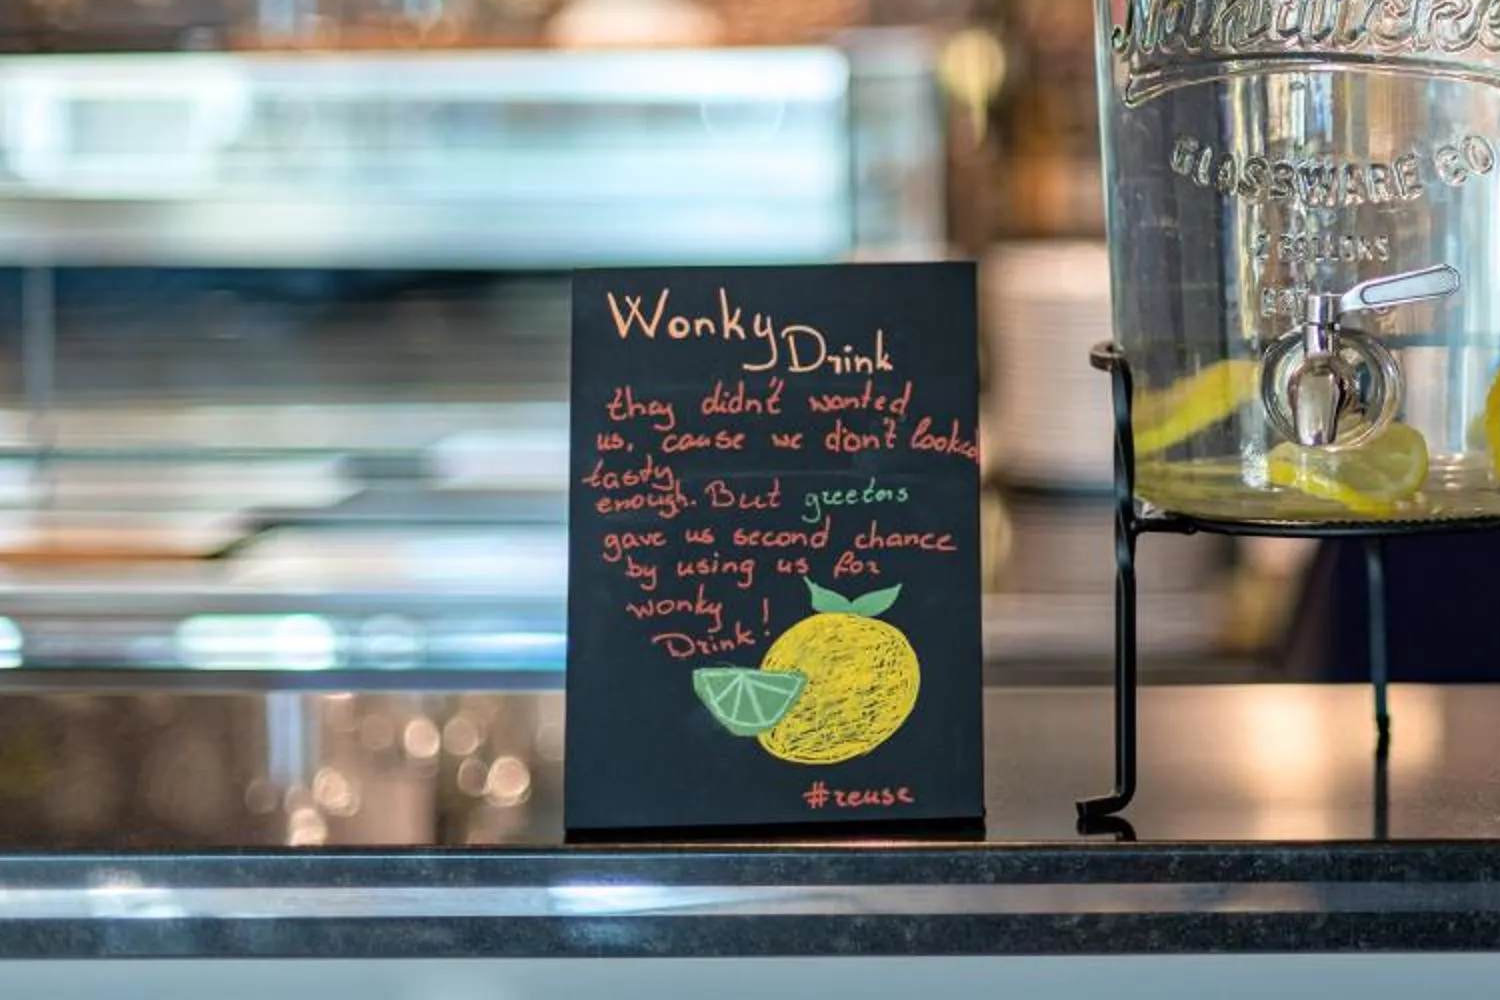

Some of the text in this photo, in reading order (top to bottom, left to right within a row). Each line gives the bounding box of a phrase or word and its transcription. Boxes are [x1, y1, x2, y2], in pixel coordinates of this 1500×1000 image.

[1170, 134, 1496, 206] GLASSWARE CO
[606, 287, 894, 373] Wonky Drink
[662, 429, 747, 452] cause
[770, 430, 804, 450] we
[581, 453, 676, 491] tasty
[704, 480, 782, 509] But
[602, 514, 958, 563] gave us second chance
[624, 550, 881, 591] by using us for
[626, 584, 723, 633] wonky
[802, 780, 915, 809] #reuse
